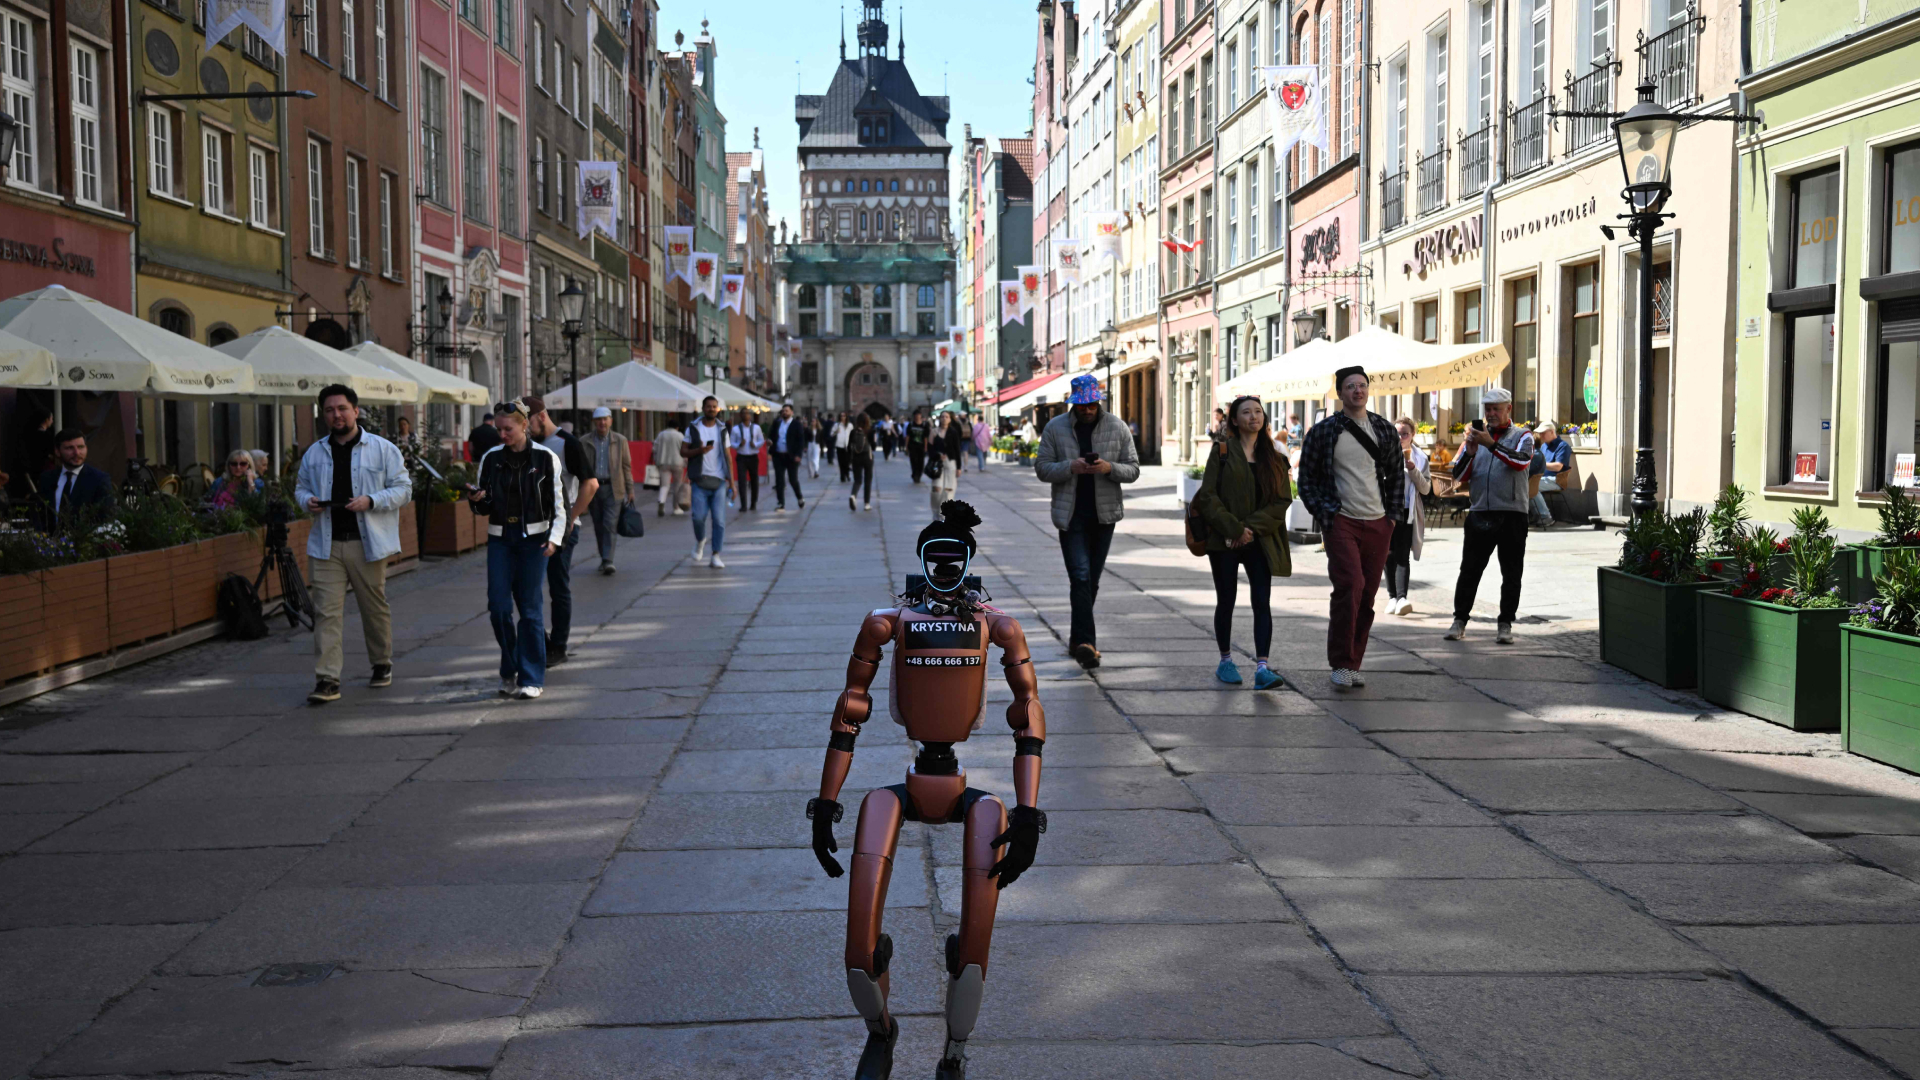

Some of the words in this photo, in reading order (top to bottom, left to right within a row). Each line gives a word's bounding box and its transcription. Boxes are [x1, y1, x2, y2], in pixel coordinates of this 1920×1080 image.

[1501, 223, 1525, 243] LODY
[1528, 219, 1541, 235] OD
[1544, 195, 1596, 229] POKOLEŃ
[1800, 214, 1839, 246] LOD
[1401, 214, 1483, 274] GRYCAN
[1449, 350, 1496, 375] GRYCAN
[88, 369, 115, 380] SOWA
[1369, 372, 1418, 382] RYCAN
[911, 622, 976, 632] KRYSTYNA
[906, 657, 922, 665] +48
[924, 657, 942, 665] 666
[944, 657, 962, 665] 666
[964, 656, 980, 665] 137
